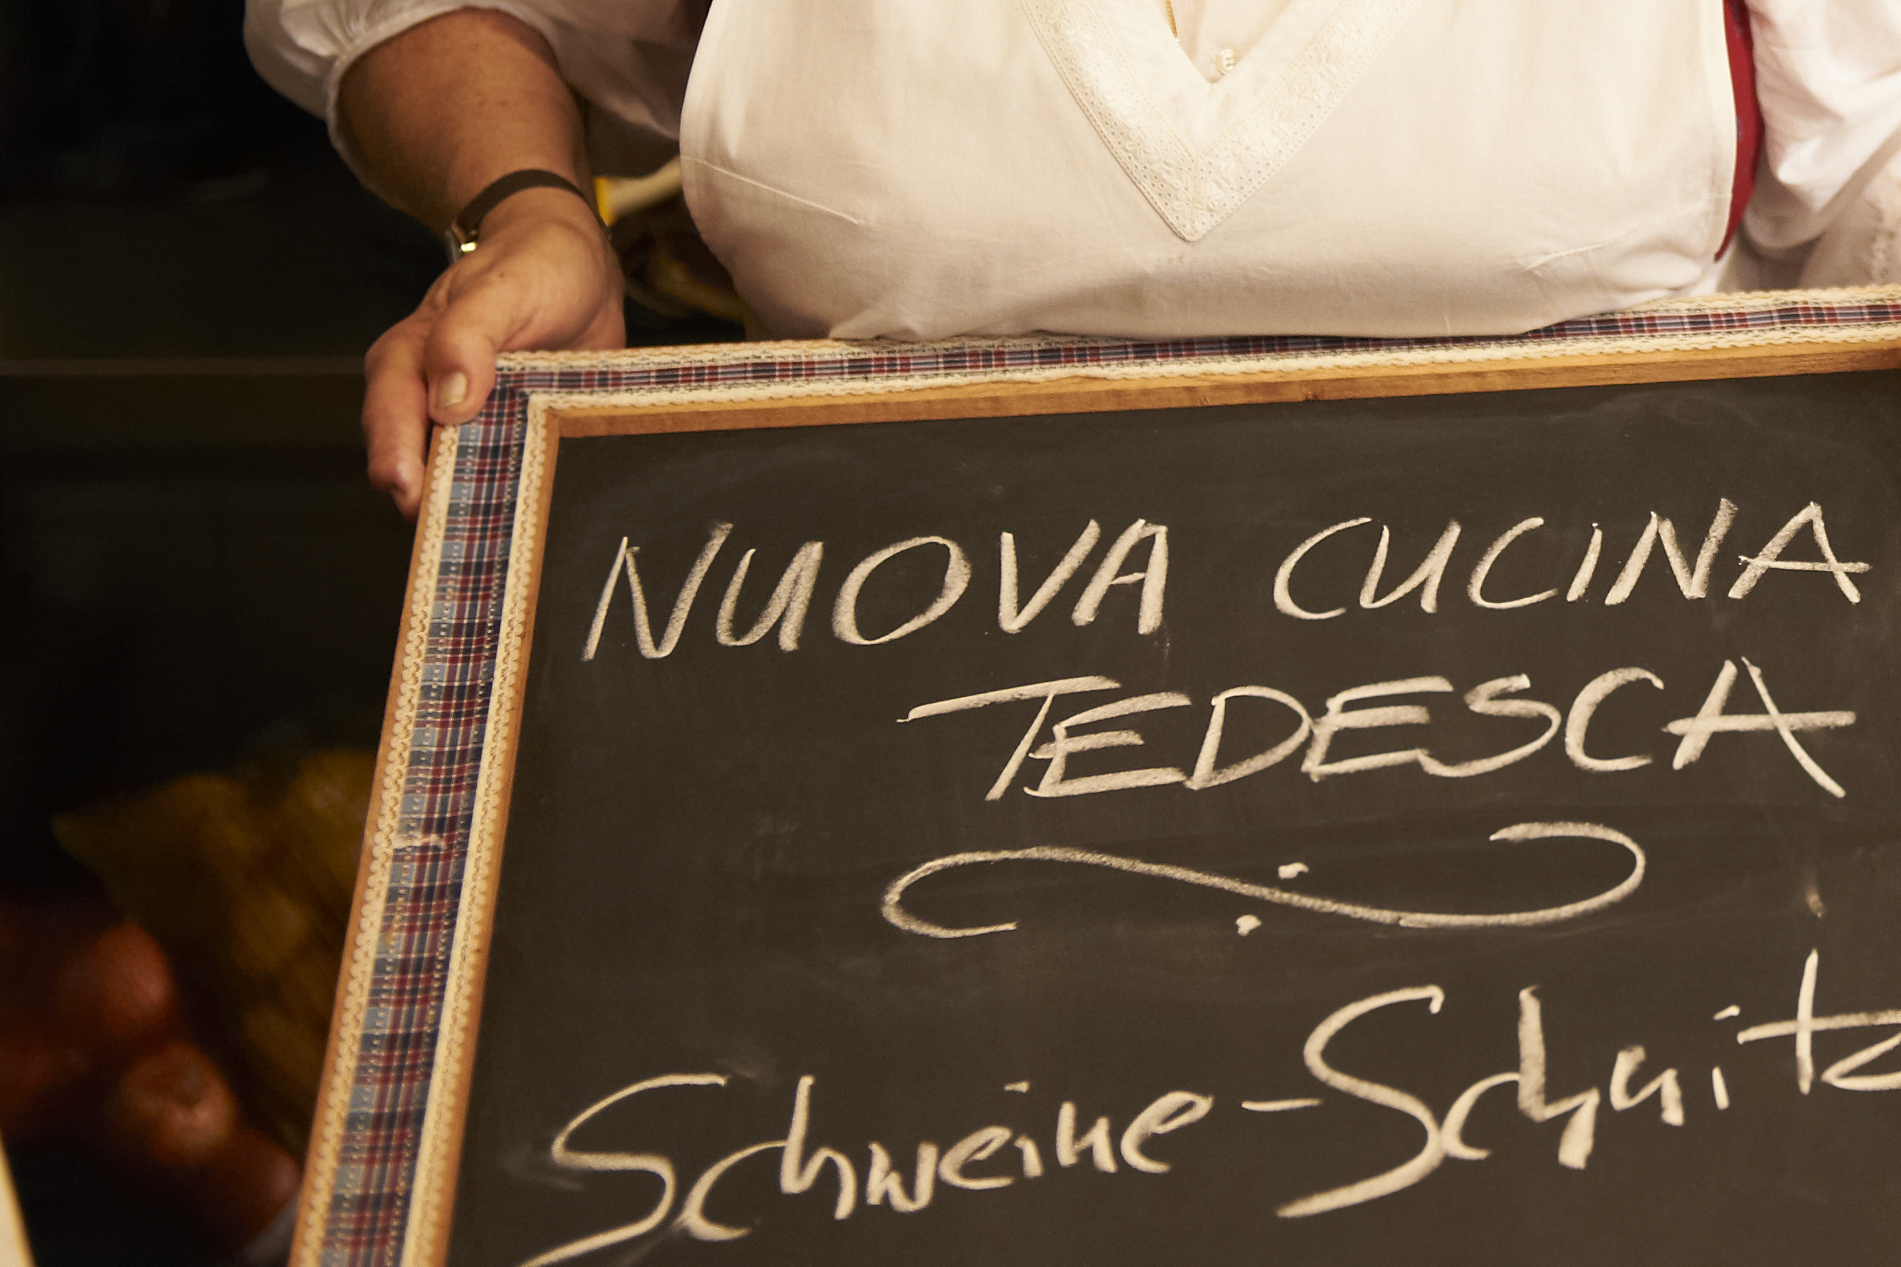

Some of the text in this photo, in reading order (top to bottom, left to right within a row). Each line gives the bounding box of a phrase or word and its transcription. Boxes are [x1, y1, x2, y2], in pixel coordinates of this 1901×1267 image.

[582, 496, 1873, 663] NUOVA CUCINA
[894, 654, 1858, 803] TEDESCA
